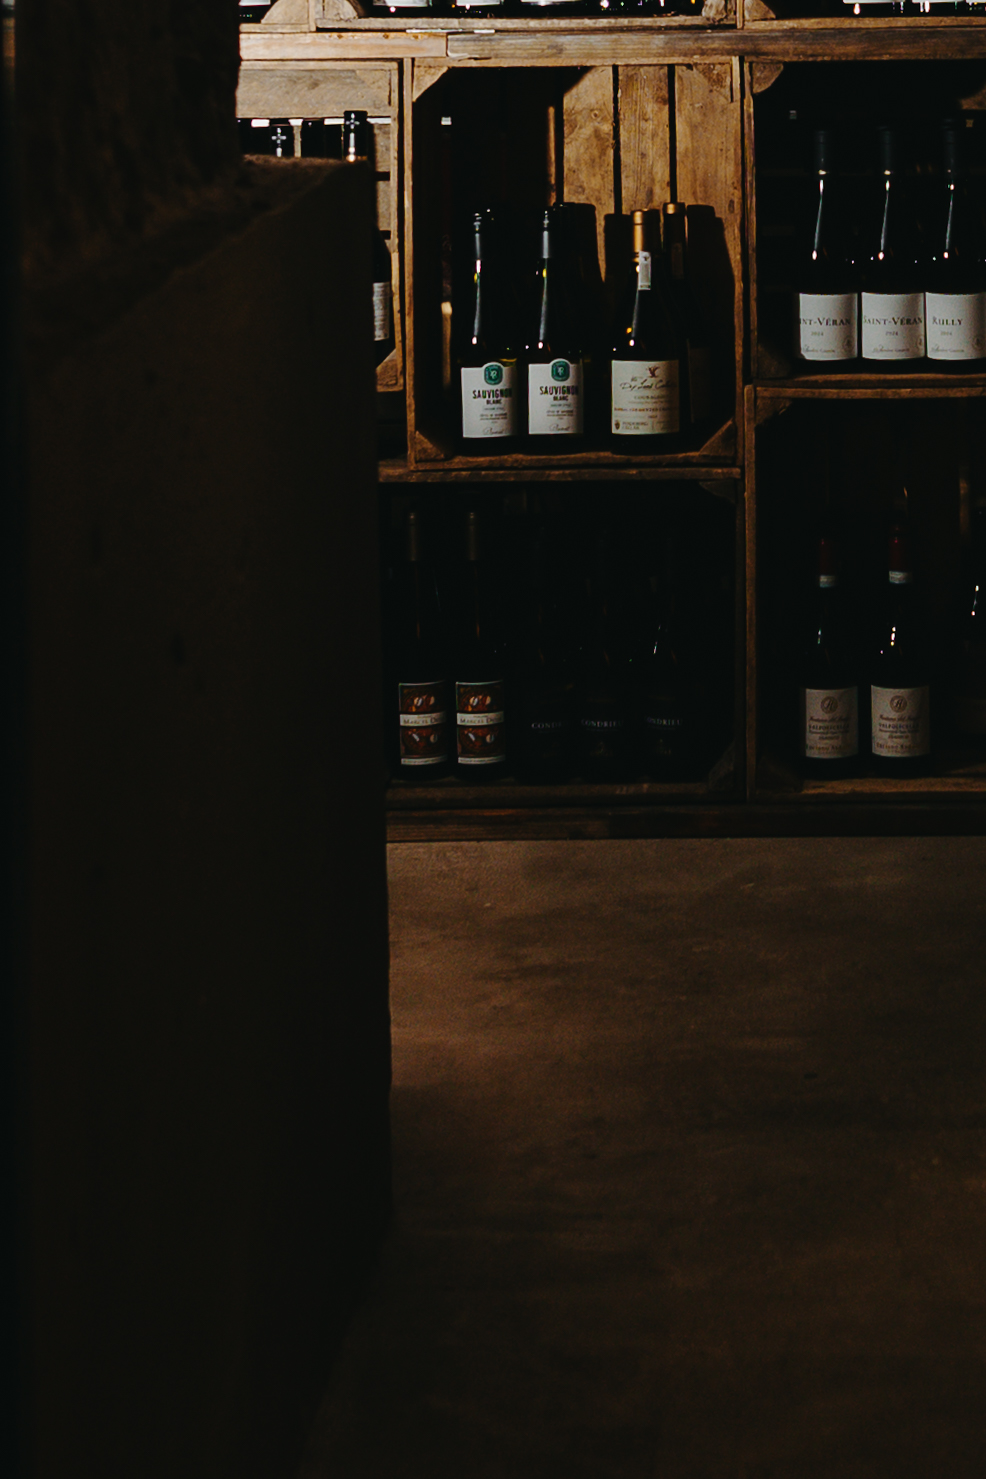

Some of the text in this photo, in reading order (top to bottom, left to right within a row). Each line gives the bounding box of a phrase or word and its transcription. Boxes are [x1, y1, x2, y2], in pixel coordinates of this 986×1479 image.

[932, 315, 963, 326] RULLY
[472, 388, 512, 399] SAUVIGNON
[539, 384, 579, 396] SAUVIGNON
